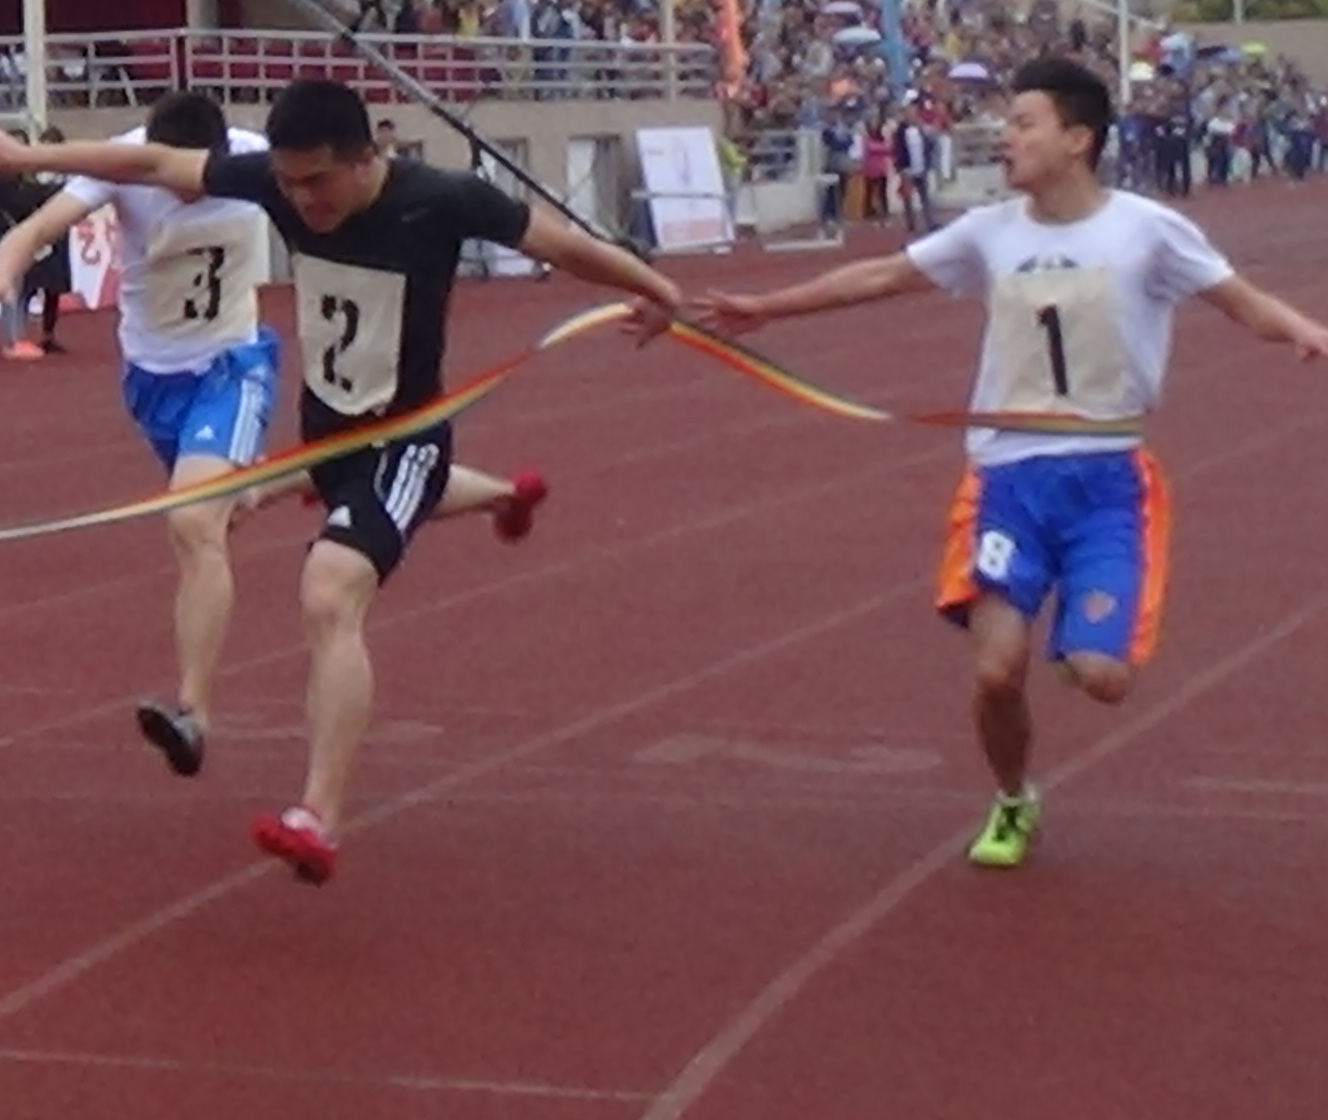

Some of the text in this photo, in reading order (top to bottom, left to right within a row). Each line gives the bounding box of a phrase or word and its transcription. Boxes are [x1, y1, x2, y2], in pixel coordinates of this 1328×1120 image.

[184, 246, 225, 320] 3
[321, 294, 360, 393] 2
[1036, 304, 1069, 396] 1
[978, 530, 1016, 580] 8
